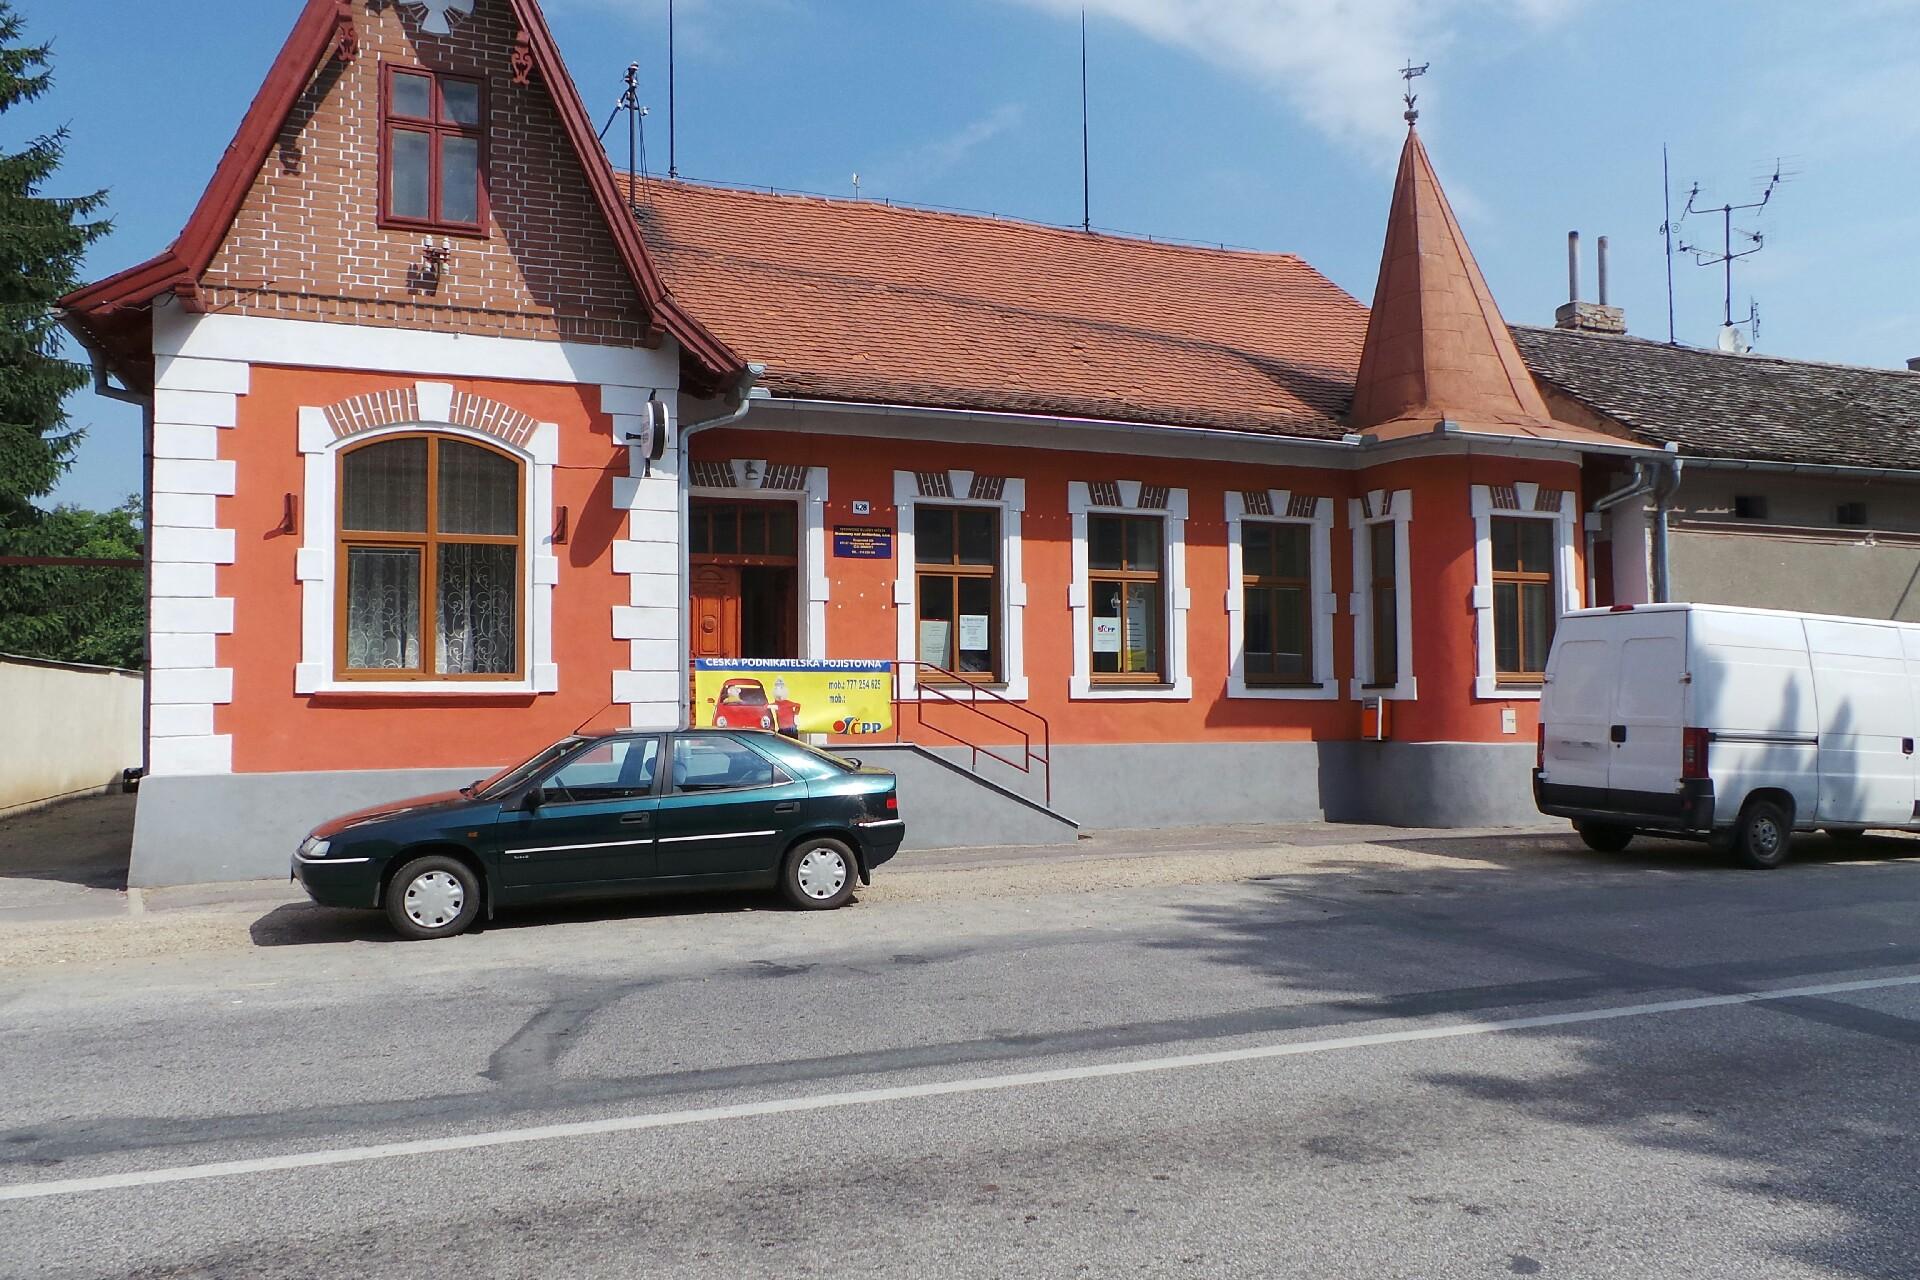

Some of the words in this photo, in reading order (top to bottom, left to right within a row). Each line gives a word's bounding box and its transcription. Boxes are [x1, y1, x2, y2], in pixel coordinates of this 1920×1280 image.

[847, 680, 857, 690] 777
[859, 680, 869, 690] 254
[871, 680, 880, 690] 625
[850, 718, 882, 734] ČPP
